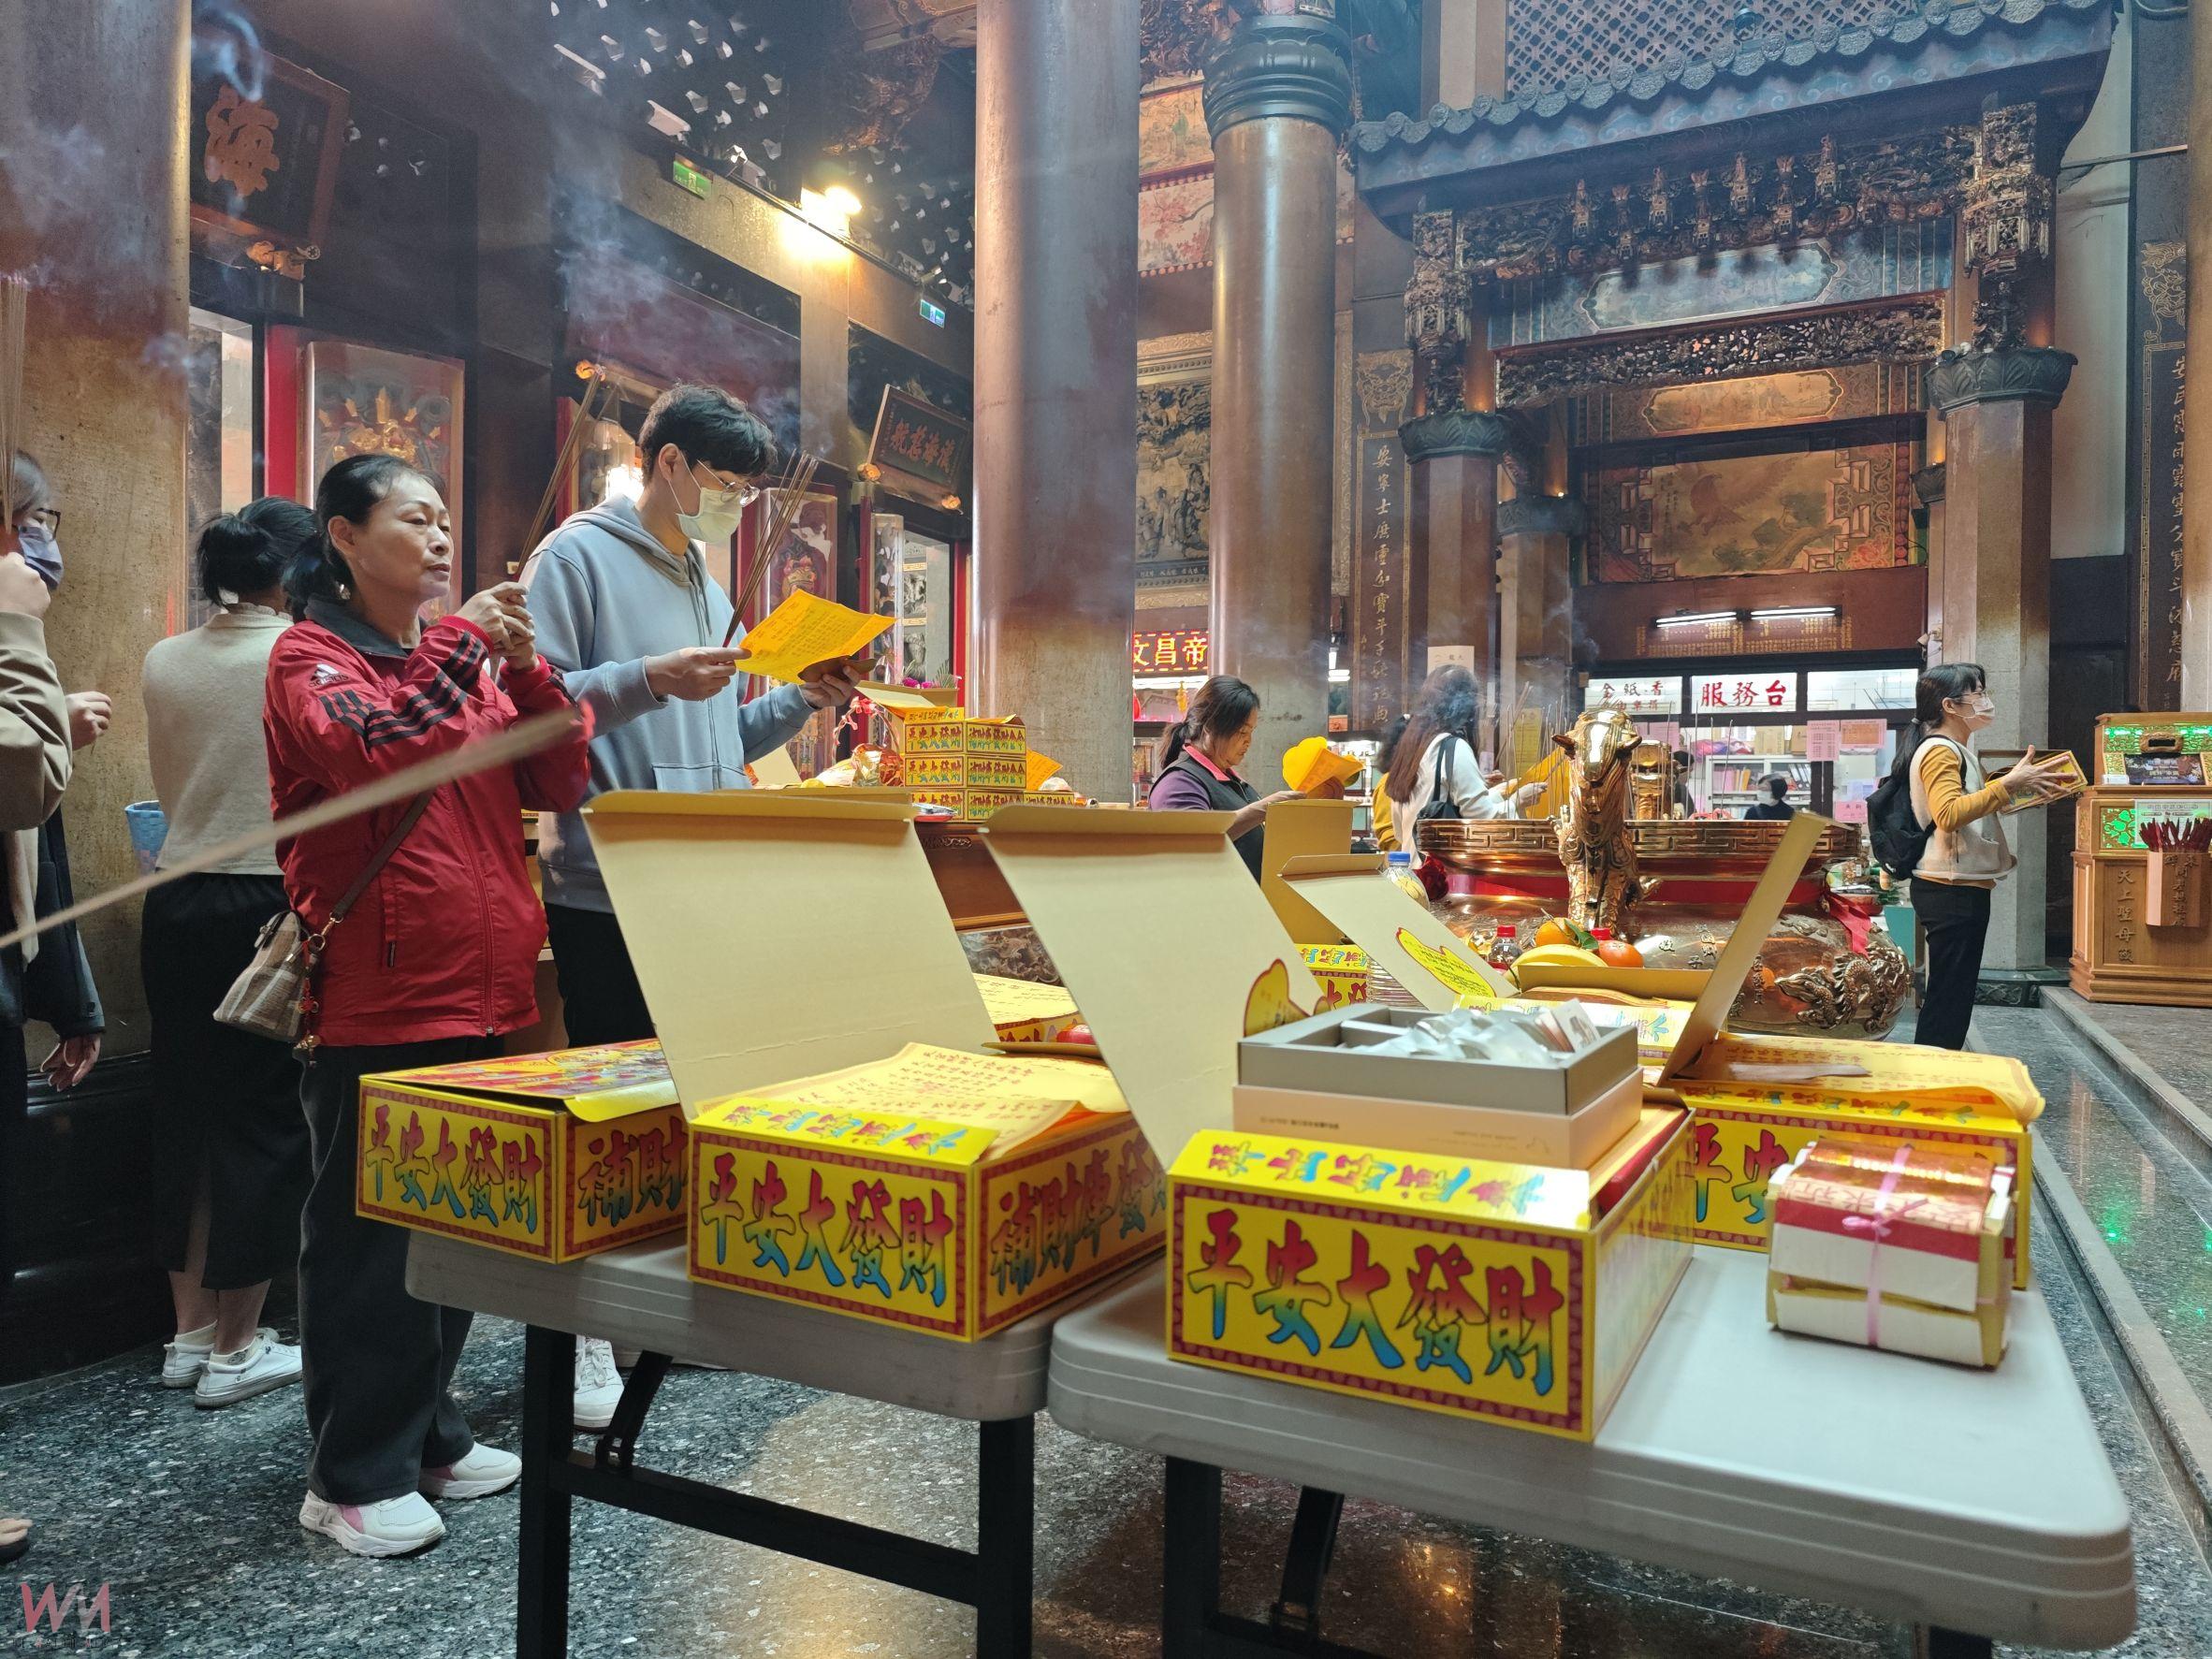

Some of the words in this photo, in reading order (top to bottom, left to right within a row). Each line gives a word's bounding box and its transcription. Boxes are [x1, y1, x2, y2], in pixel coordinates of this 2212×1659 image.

[1133, 636, 1208, 665] 文昌帝
[1701, 679, 1786, 707] 服務台
[909, 726, 962, 751] 平安大發財
[909, 760, 962, 784] 平安大發財
[366, 1104, 543, 1234] 平安大發財
[701, 1152, 953, 1307] 平安大發財
[1187, 1208, 1564, 1396] 平安大發財
